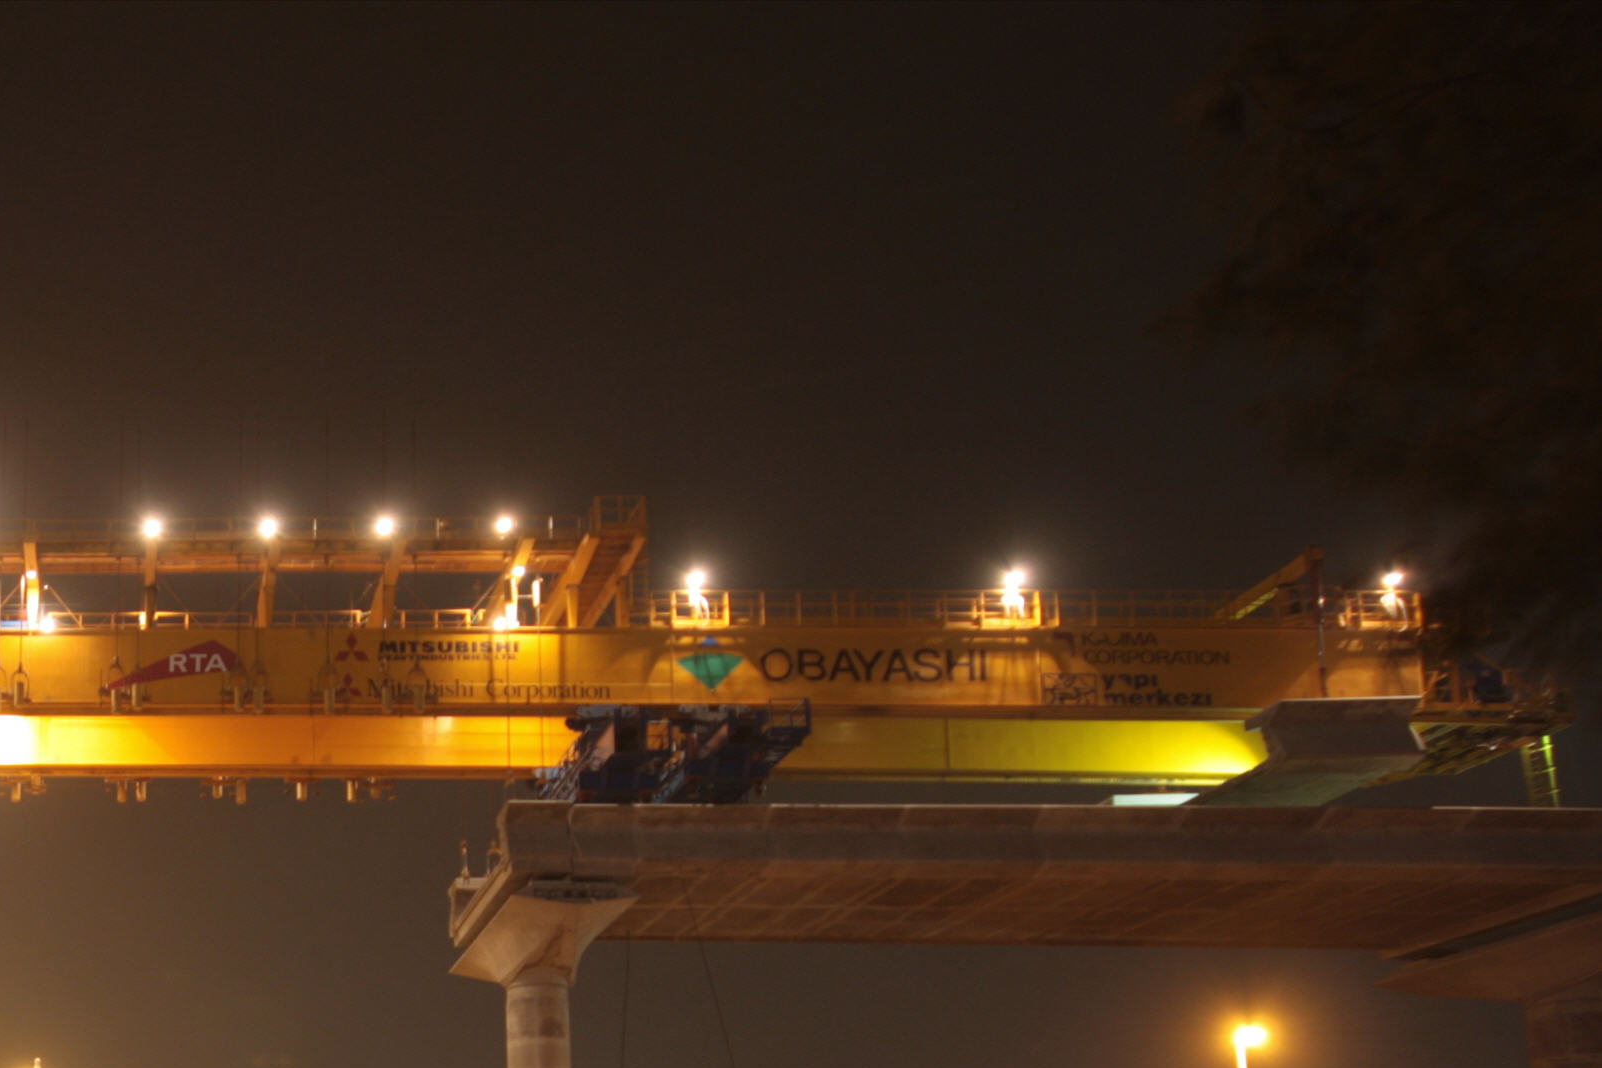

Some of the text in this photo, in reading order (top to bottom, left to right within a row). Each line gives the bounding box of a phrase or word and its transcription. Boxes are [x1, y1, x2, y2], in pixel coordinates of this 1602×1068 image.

[379, 640, 520, 652] MITSUBISHI
[168, 653, 228, 673] RTA
[760, 648, 988, 682] OBAYASHI
[1083, 650, 1231, 665] CORPORATION
[367, 678, 611, 704] Mitsbishi Corporation
